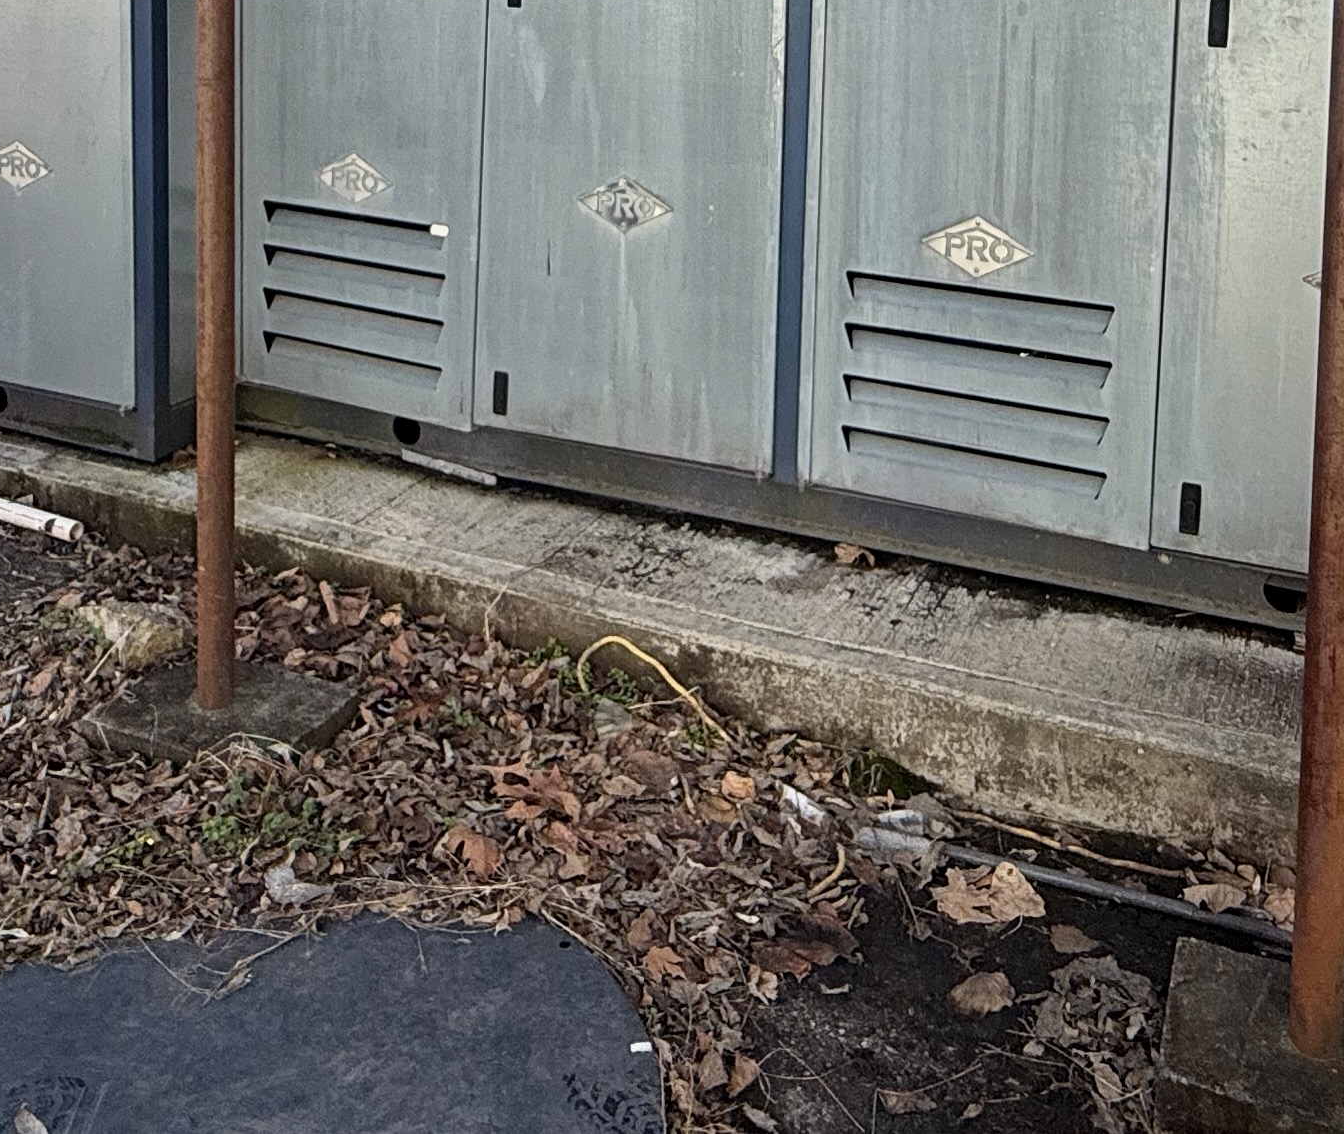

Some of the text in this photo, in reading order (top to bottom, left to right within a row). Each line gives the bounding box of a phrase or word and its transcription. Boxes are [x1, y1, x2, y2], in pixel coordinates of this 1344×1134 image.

[331, 167, 377, 193] PRO
[597, 191, 655, 217] PRO
[945, 232, 1015, 264] PRO
